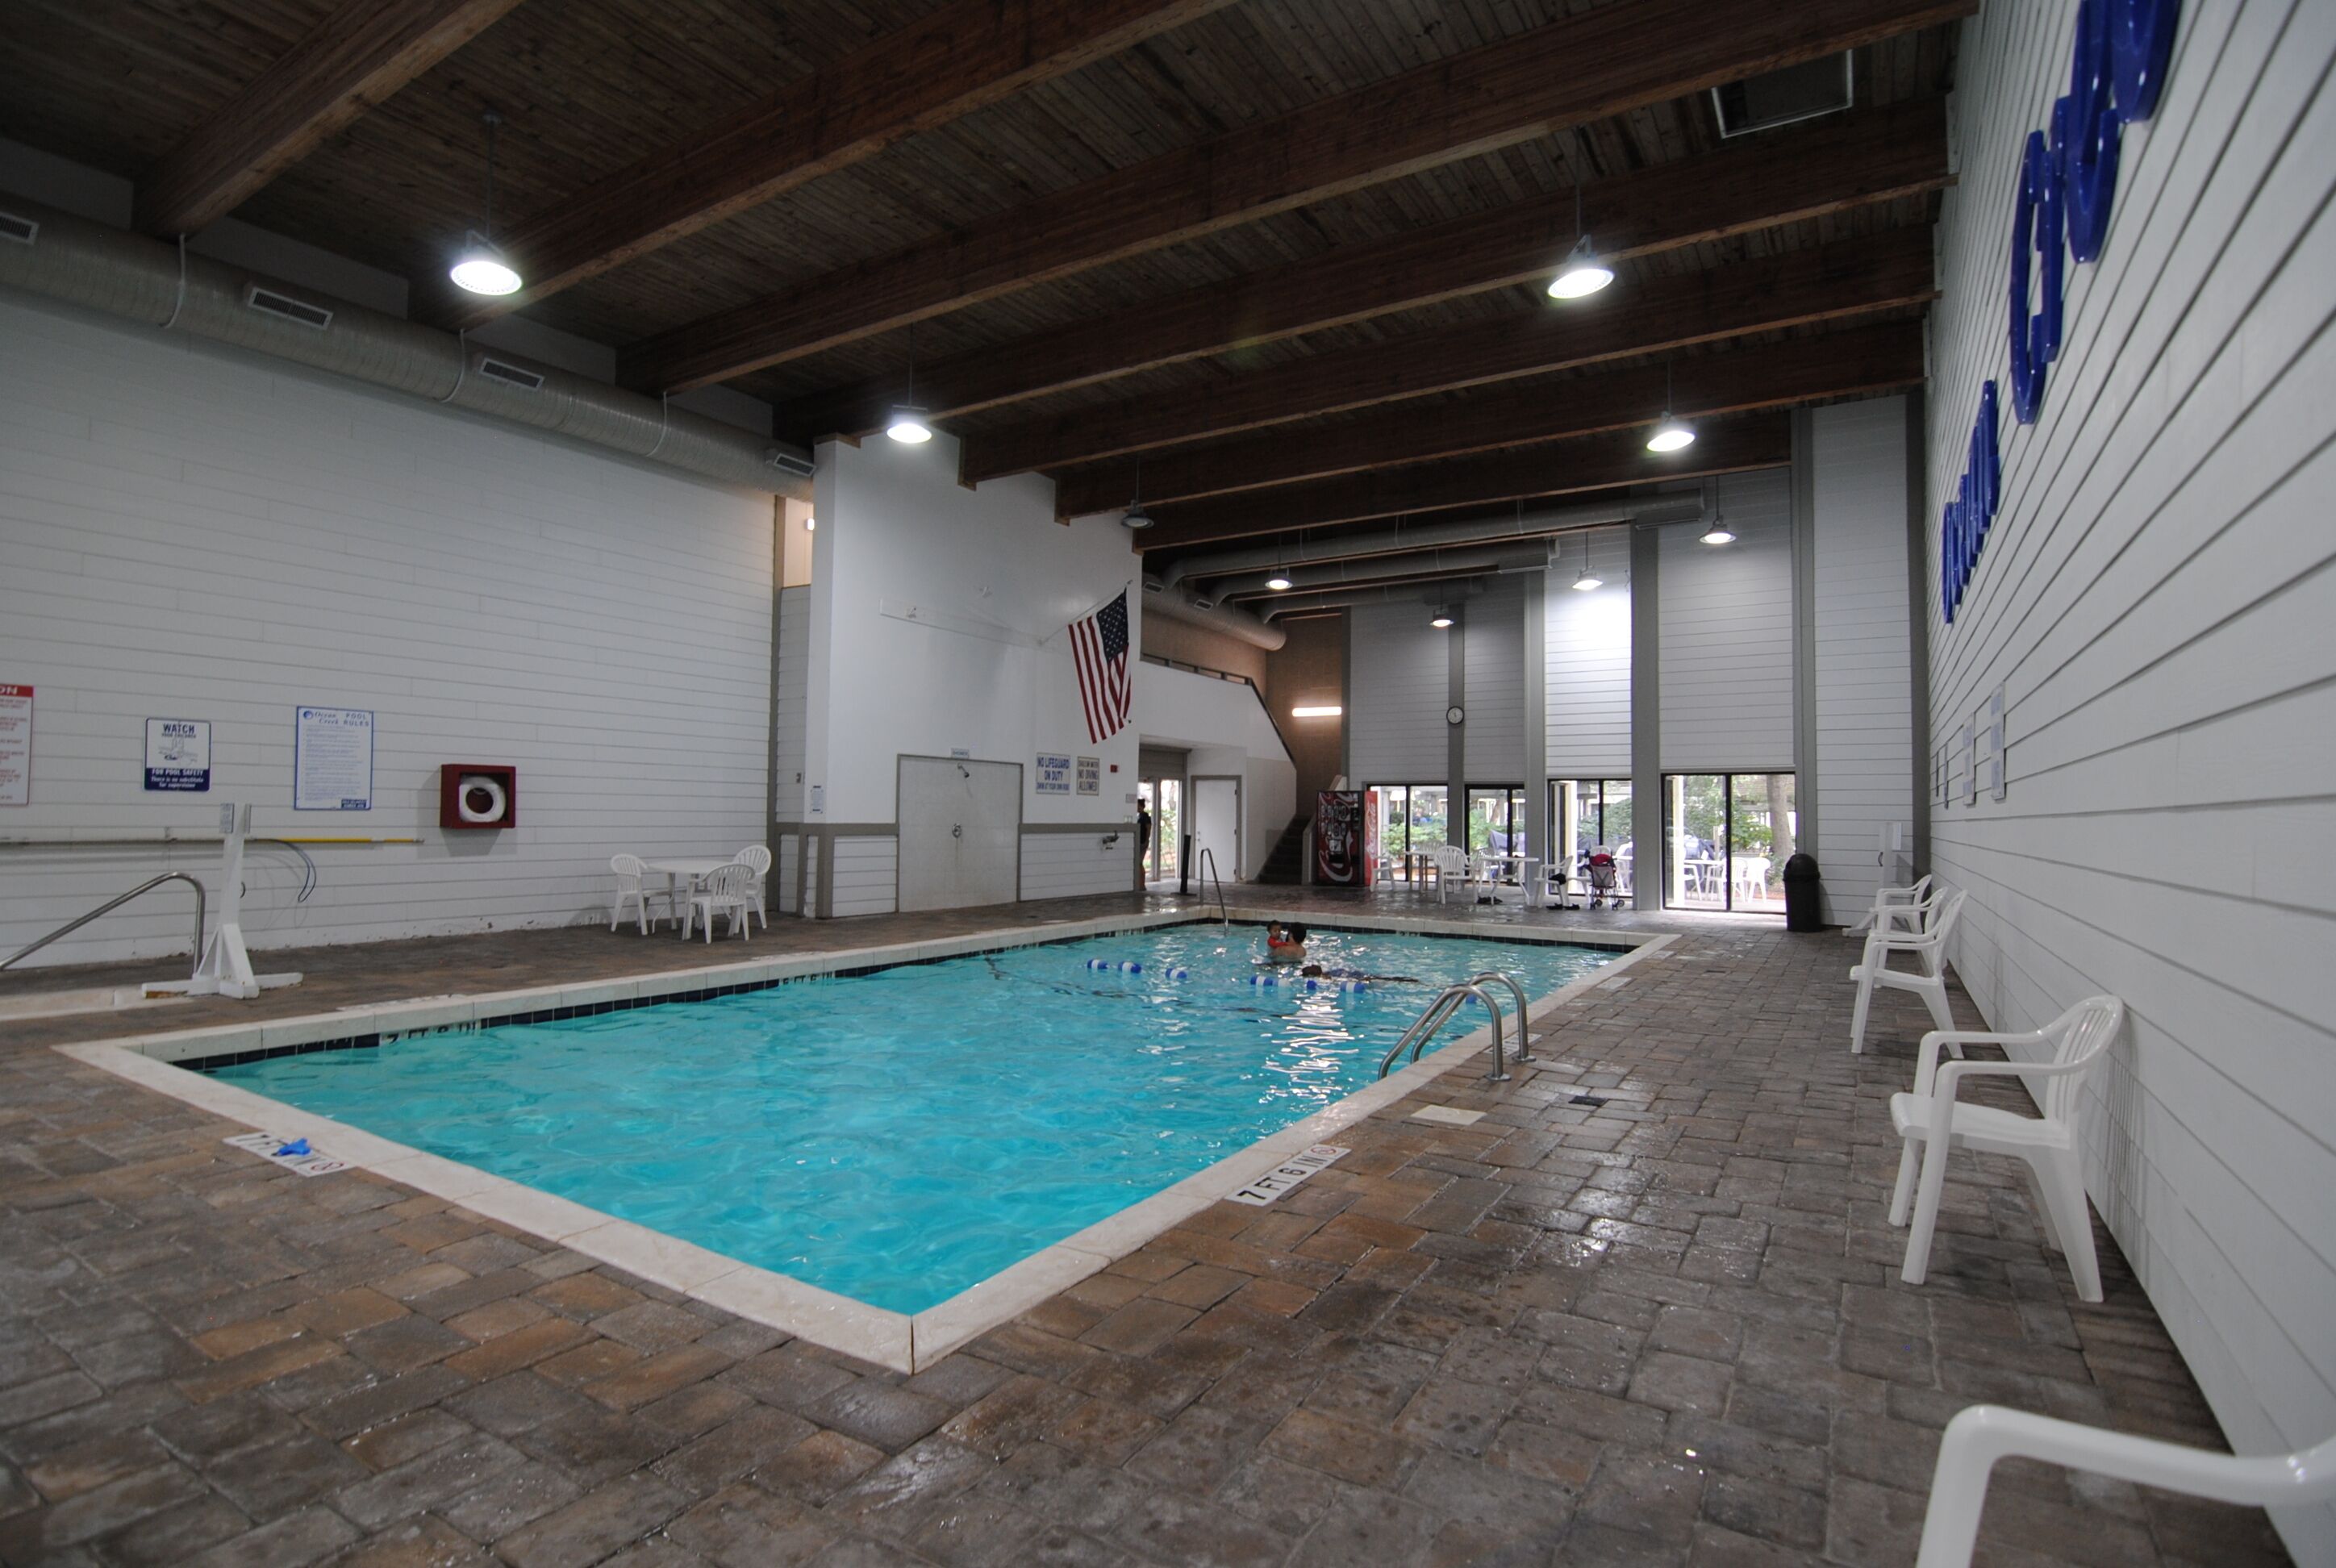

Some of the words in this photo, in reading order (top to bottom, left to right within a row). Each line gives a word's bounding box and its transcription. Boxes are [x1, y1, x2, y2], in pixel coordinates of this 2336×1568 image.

[163, 724, 195, 734] WATCH
[1037, 757, 1045, 768] NO
[1045, 757, 1070, 769] LIFEGUARD
[1045, 769, 1051, 781] ON
[1052, 770, 1063, 782] DUTY
[1078, 769, 1084, 779] NO
[1085, 769, 1098, 781] DIVING
[1078, 781, 1097, 791] ALLOWED
[387, 1033, 398, 1045] 7
[1291, 1155, 1328, 1168] IN
[1279, 1167, 1307, 1177] 6
[1254, 1176, 1291, 1191] FT
[1237, 1190, 1266, 1200] 7
